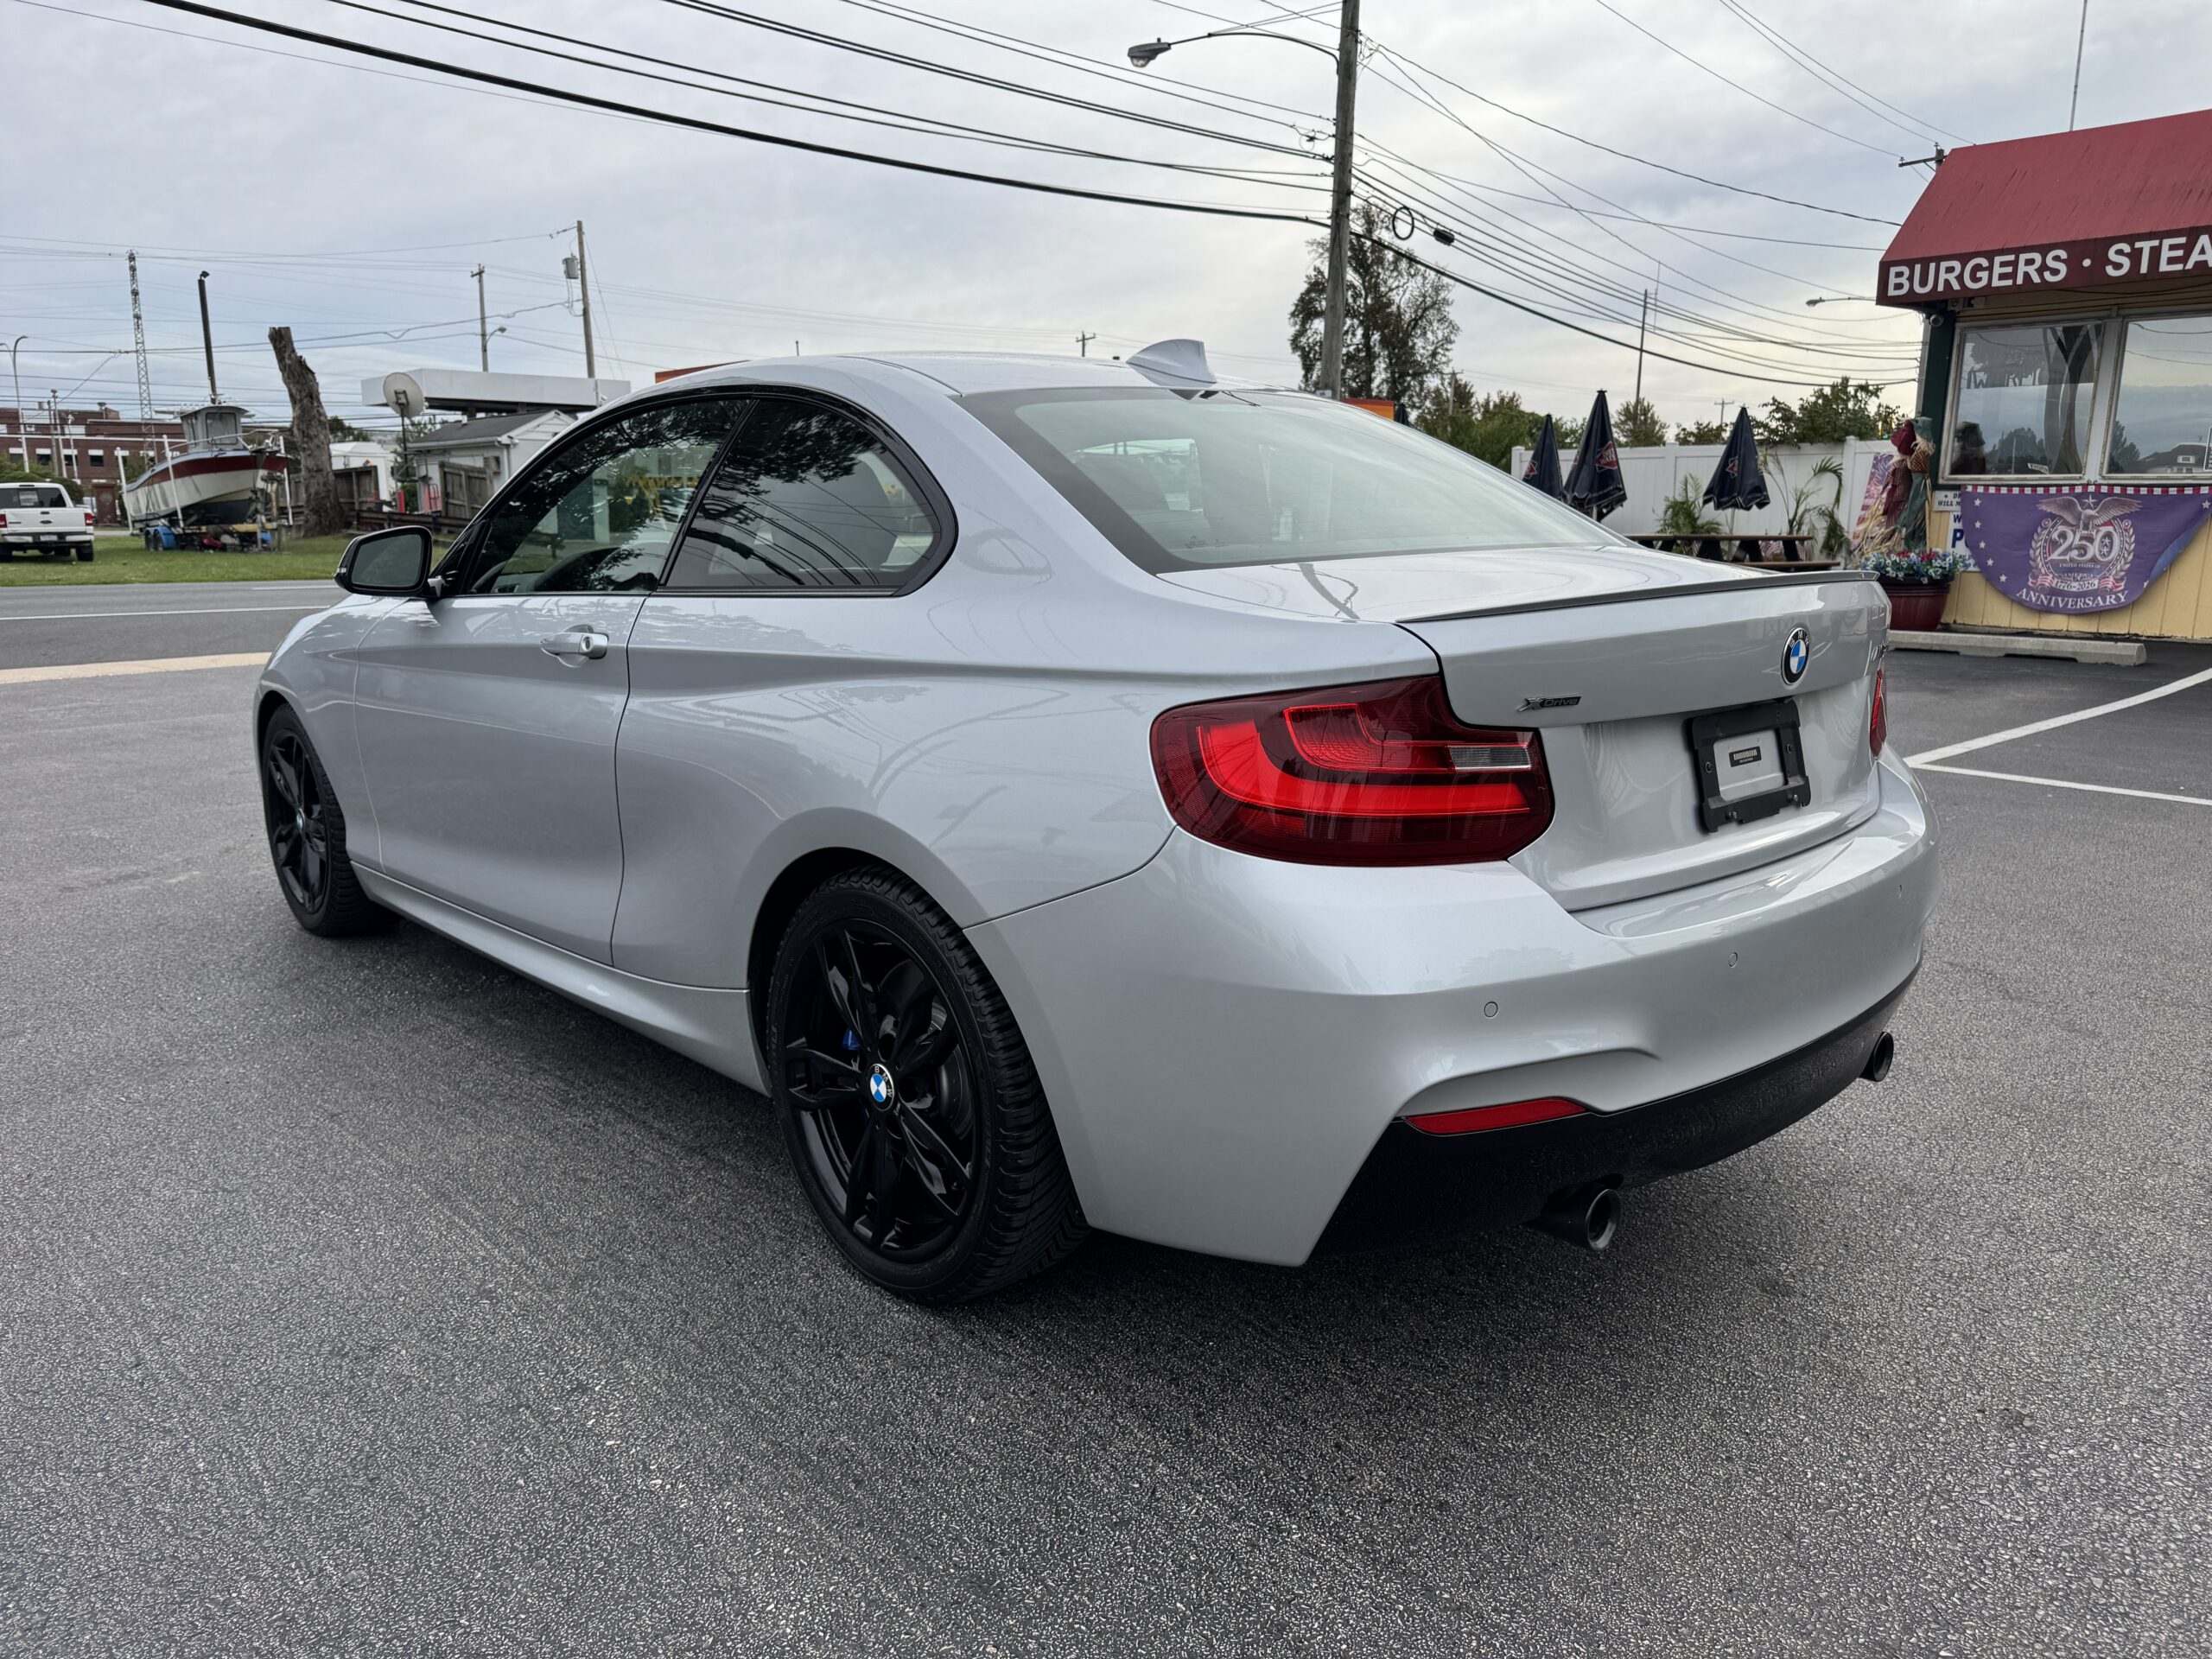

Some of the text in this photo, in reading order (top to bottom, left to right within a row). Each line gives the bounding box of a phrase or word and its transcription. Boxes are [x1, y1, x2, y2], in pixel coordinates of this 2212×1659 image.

[1887, 249, 2068, 296] BURGERS
[2045, 526, 2120, 562] 250
[2016, 588, 2129, 609] ANNIVERSARY
